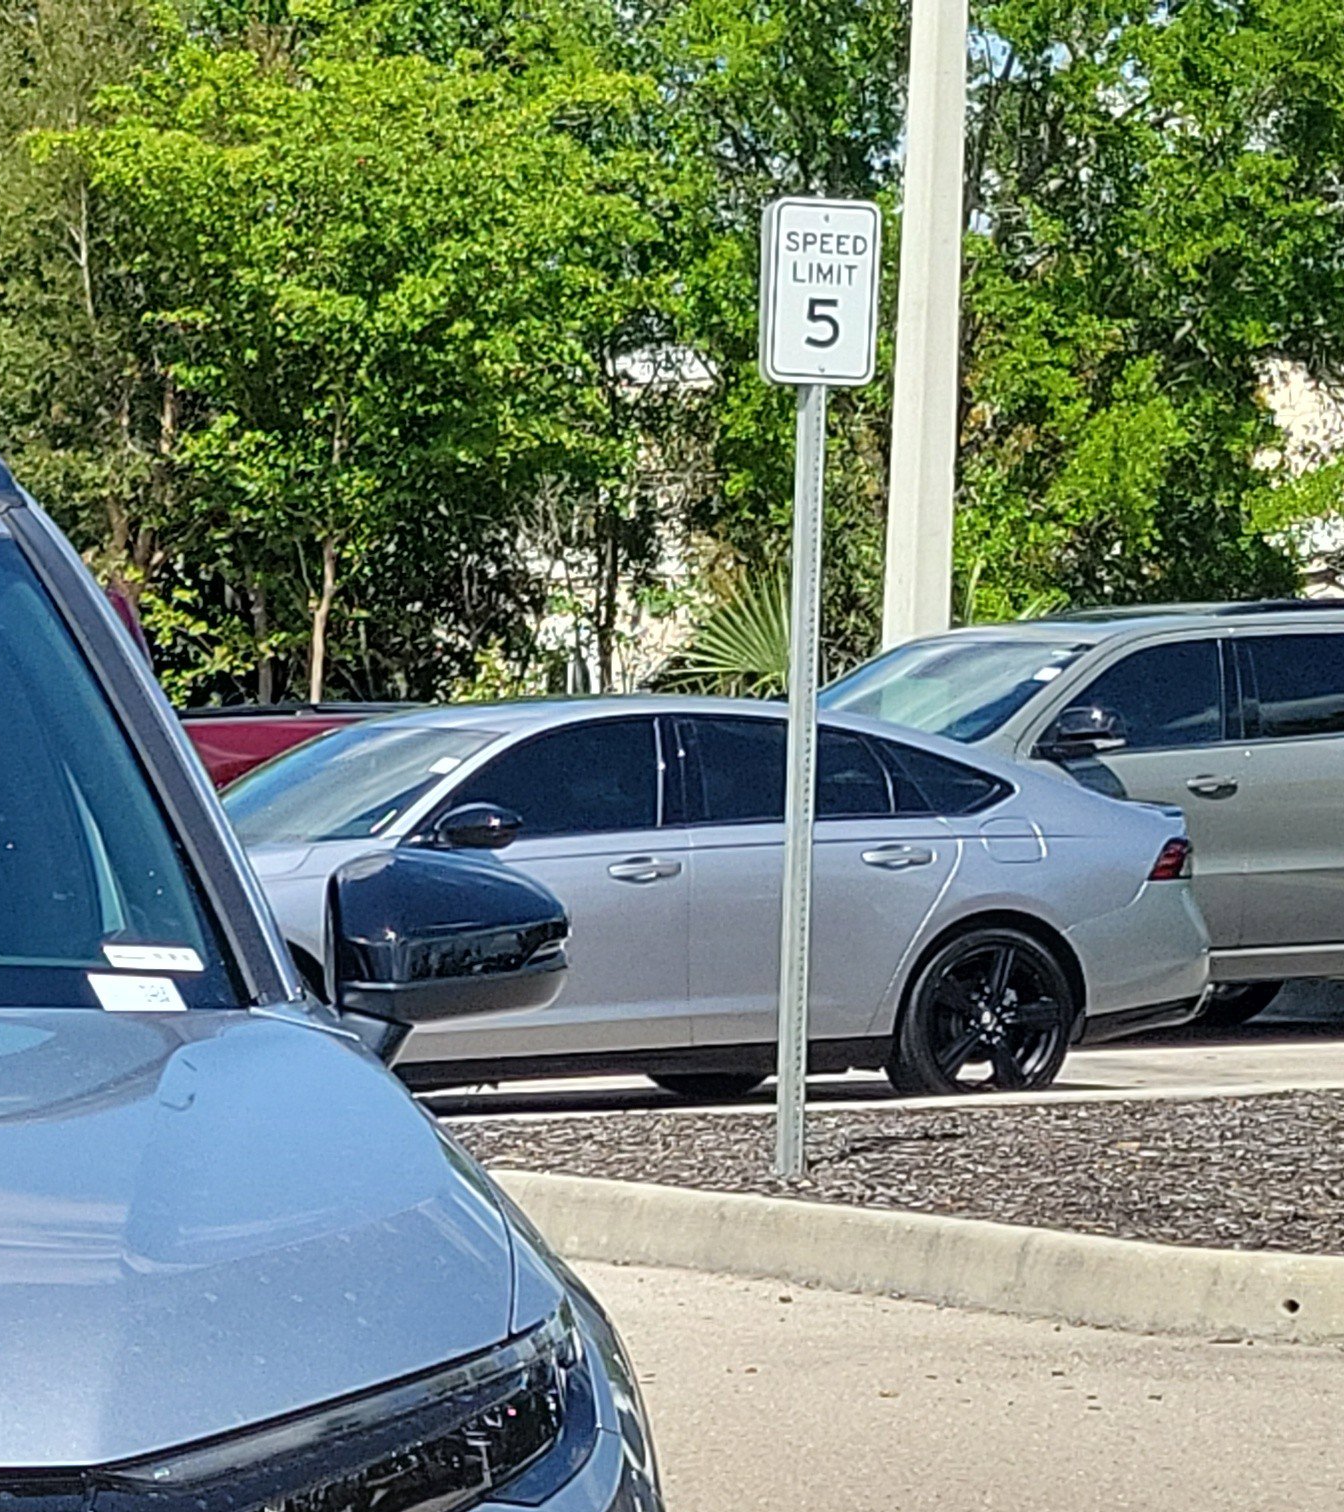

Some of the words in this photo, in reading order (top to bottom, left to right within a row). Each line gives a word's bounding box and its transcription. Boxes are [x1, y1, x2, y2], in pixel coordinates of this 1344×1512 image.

[785, 231, 868, 256] SPEED
[792, 260, 858, 286] LIMIT
[804, 297, 840, 348] 5
